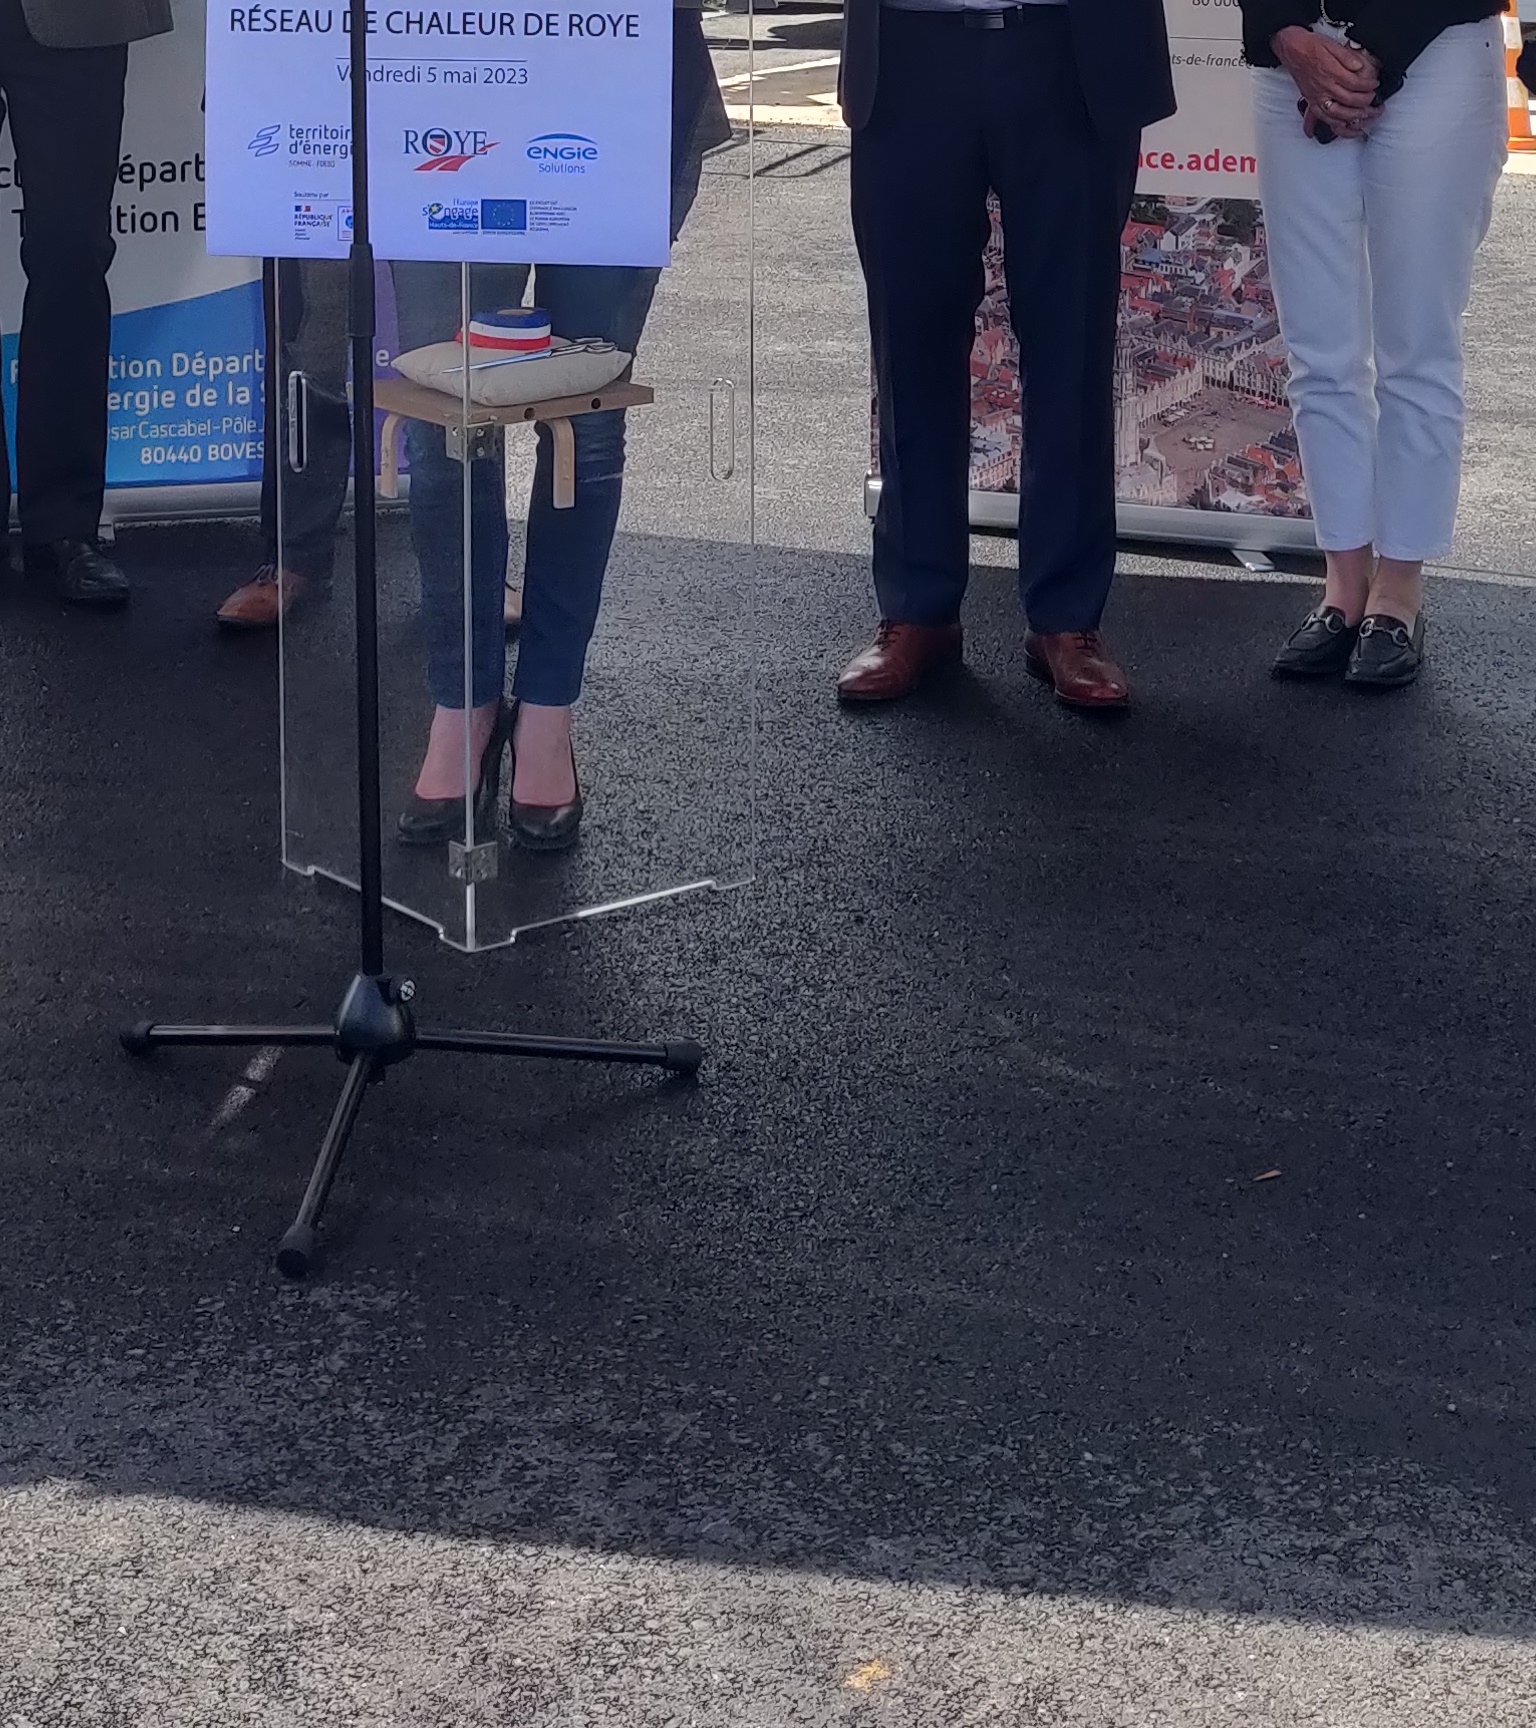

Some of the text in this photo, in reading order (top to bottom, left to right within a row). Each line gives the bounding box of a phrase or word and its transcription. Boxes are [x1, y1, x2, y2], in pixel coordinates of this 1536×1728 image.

[230, 4, 333, 33] RÉSEAU
[385, 10, 515, 36] CHALEUR
[523, 12, 560, 37] DE
[568, 13, 640, 38] ROYE
[336, 64, 528, 85] Vndredi 5 mai 2023
[289, 124, 351, 140] territoir
[403, 127, 489, 156] ROYE
[289, 140, 353, 160] d'énergi
[118, 153, 206, 192] épart
[539, 163, 585, 174] Solutions
[108, 348, 264, 383] tion Départ
[107, 384, 177, 417] ergie
[185, 382, 218, 408] de
[227, 380, 251, 406] la
[109, 426, 135, 441] sar
[140, 444, 202, 465] 80440
